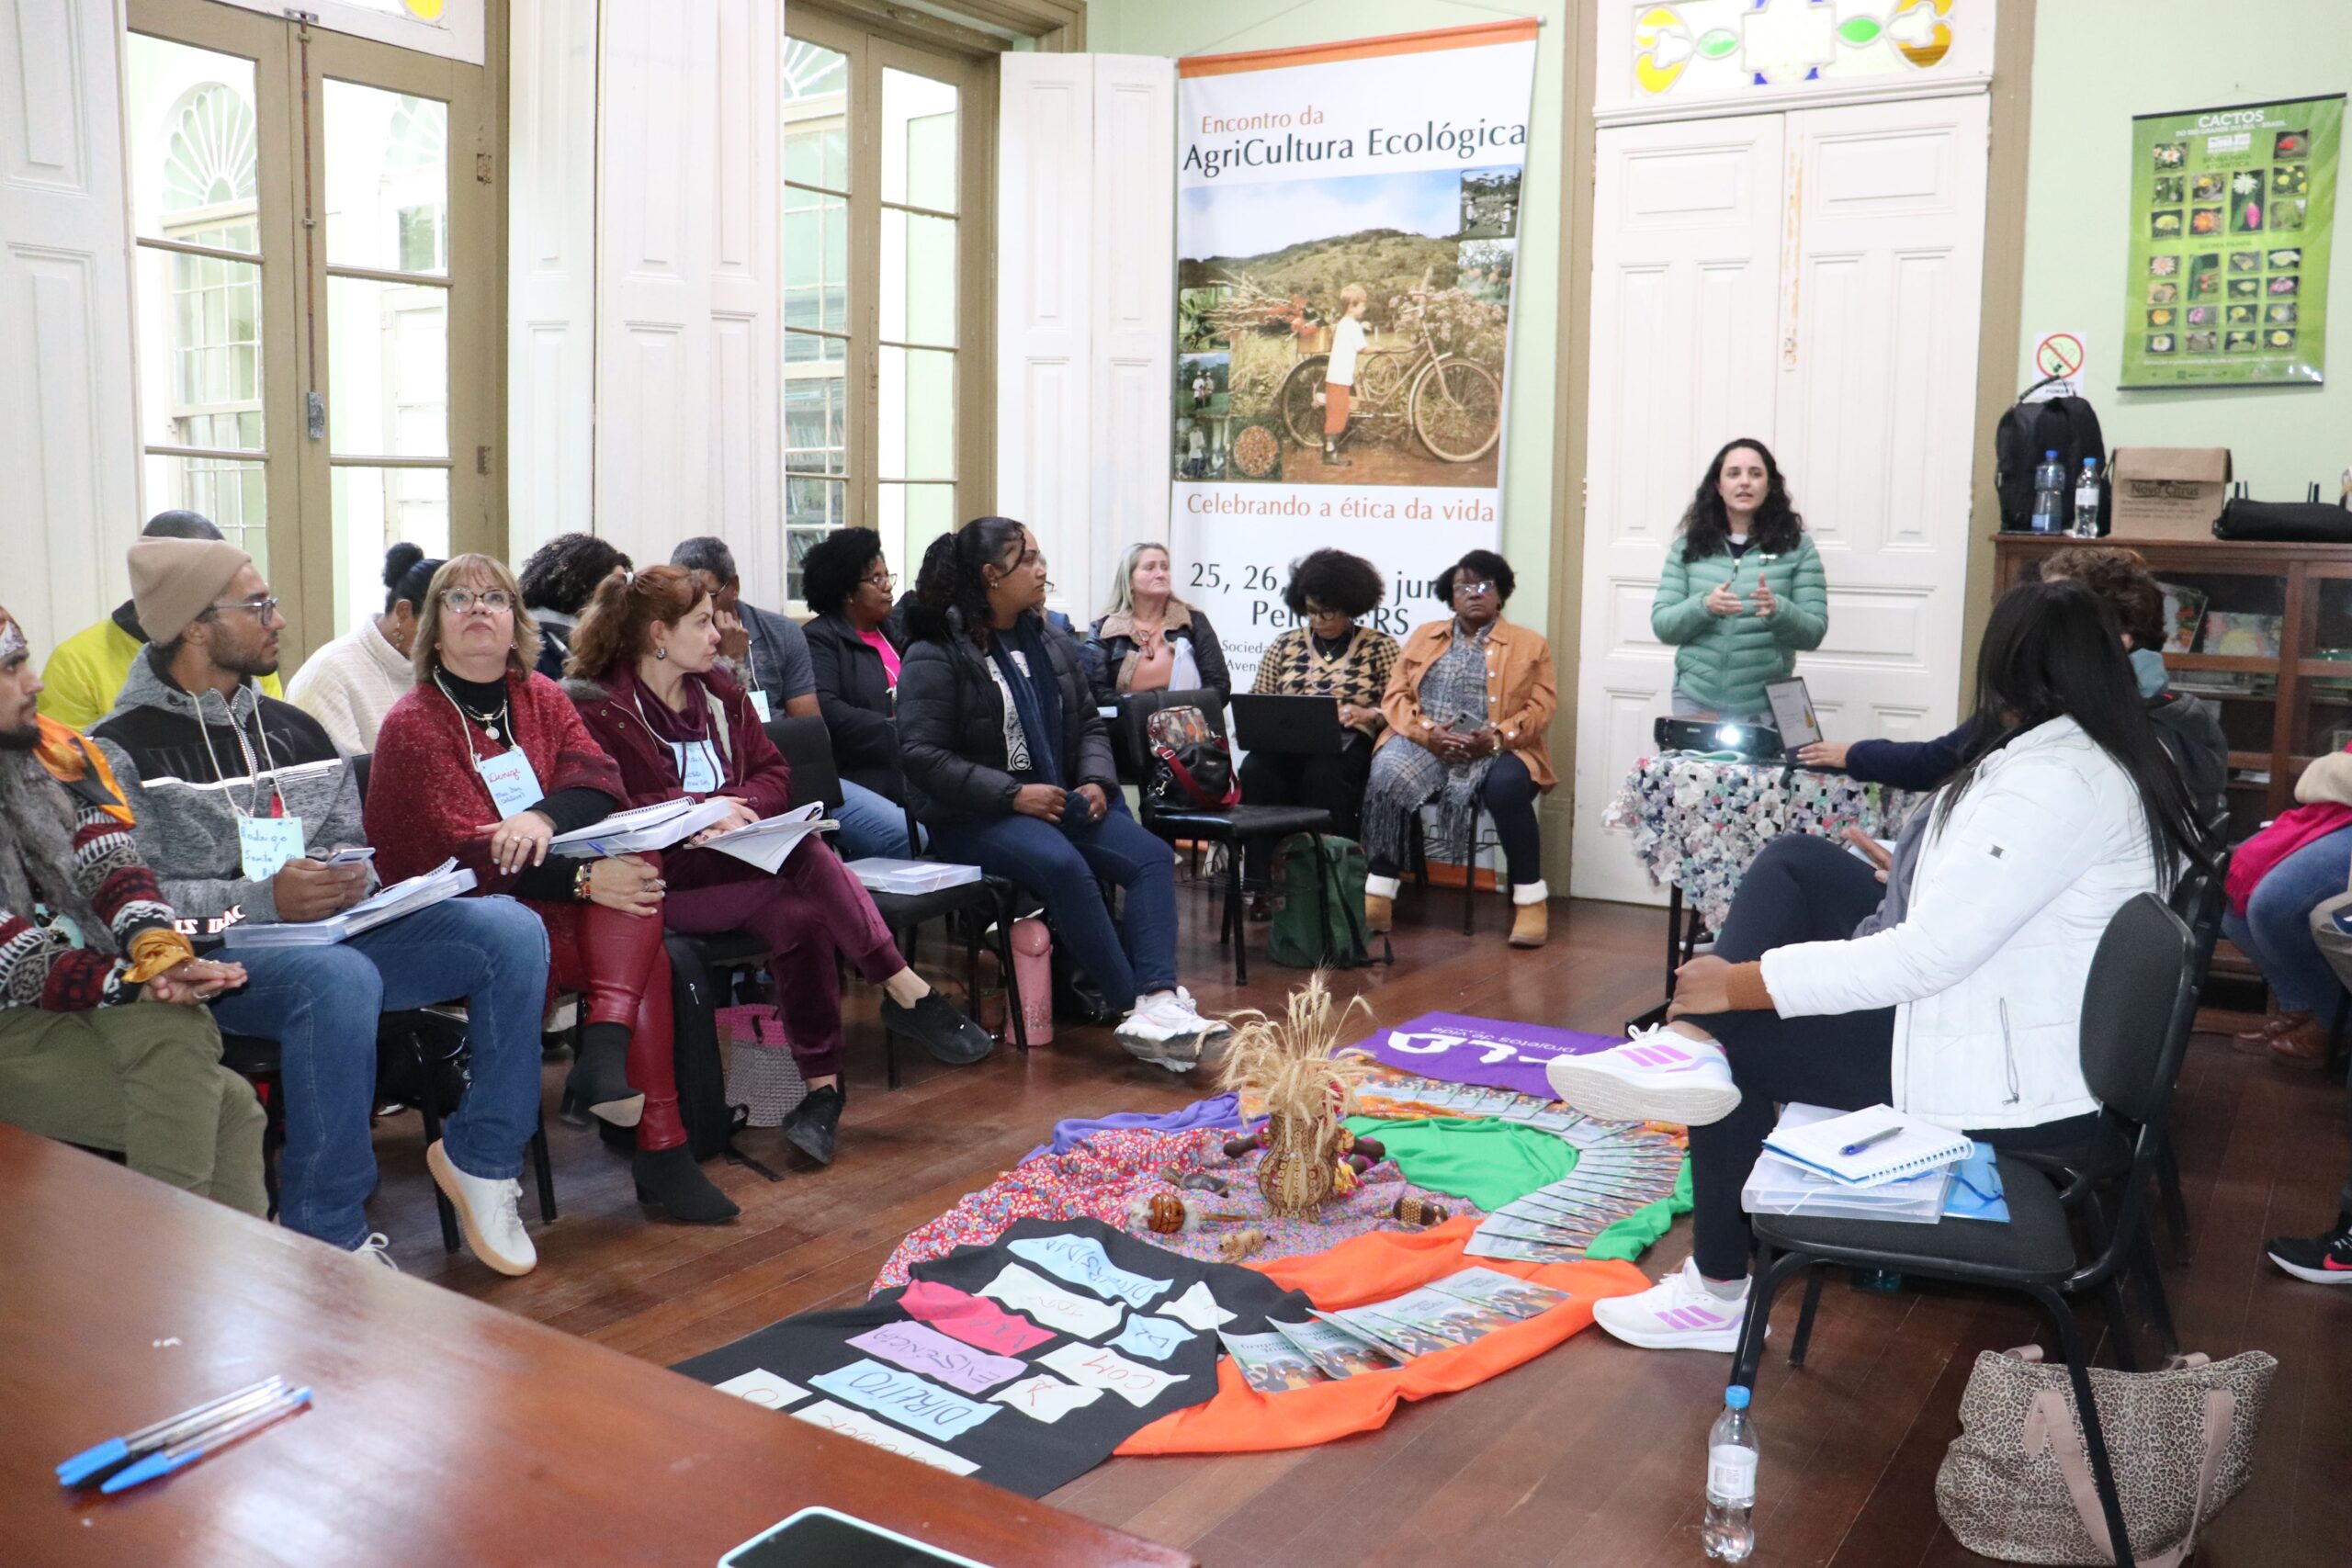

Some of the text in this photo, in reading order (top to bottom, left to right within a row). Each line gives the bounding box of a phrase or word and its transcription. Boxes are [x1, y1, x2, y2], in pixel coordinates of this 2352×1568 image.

[1202, 105, 1324, 134] Encontro da
[2198, 109, 2265, 128] CACTOS
[1183, 118, 1527, 178] AgriCultura Ecológica
[1187, 493, 1495, 523] Celebrando a ética da vida
[1190, 562, 1286, 597] 25, 26,
[1081, 1354, 1155, 1390] COM
[849, 1371, 973, 1426] DIREITO
